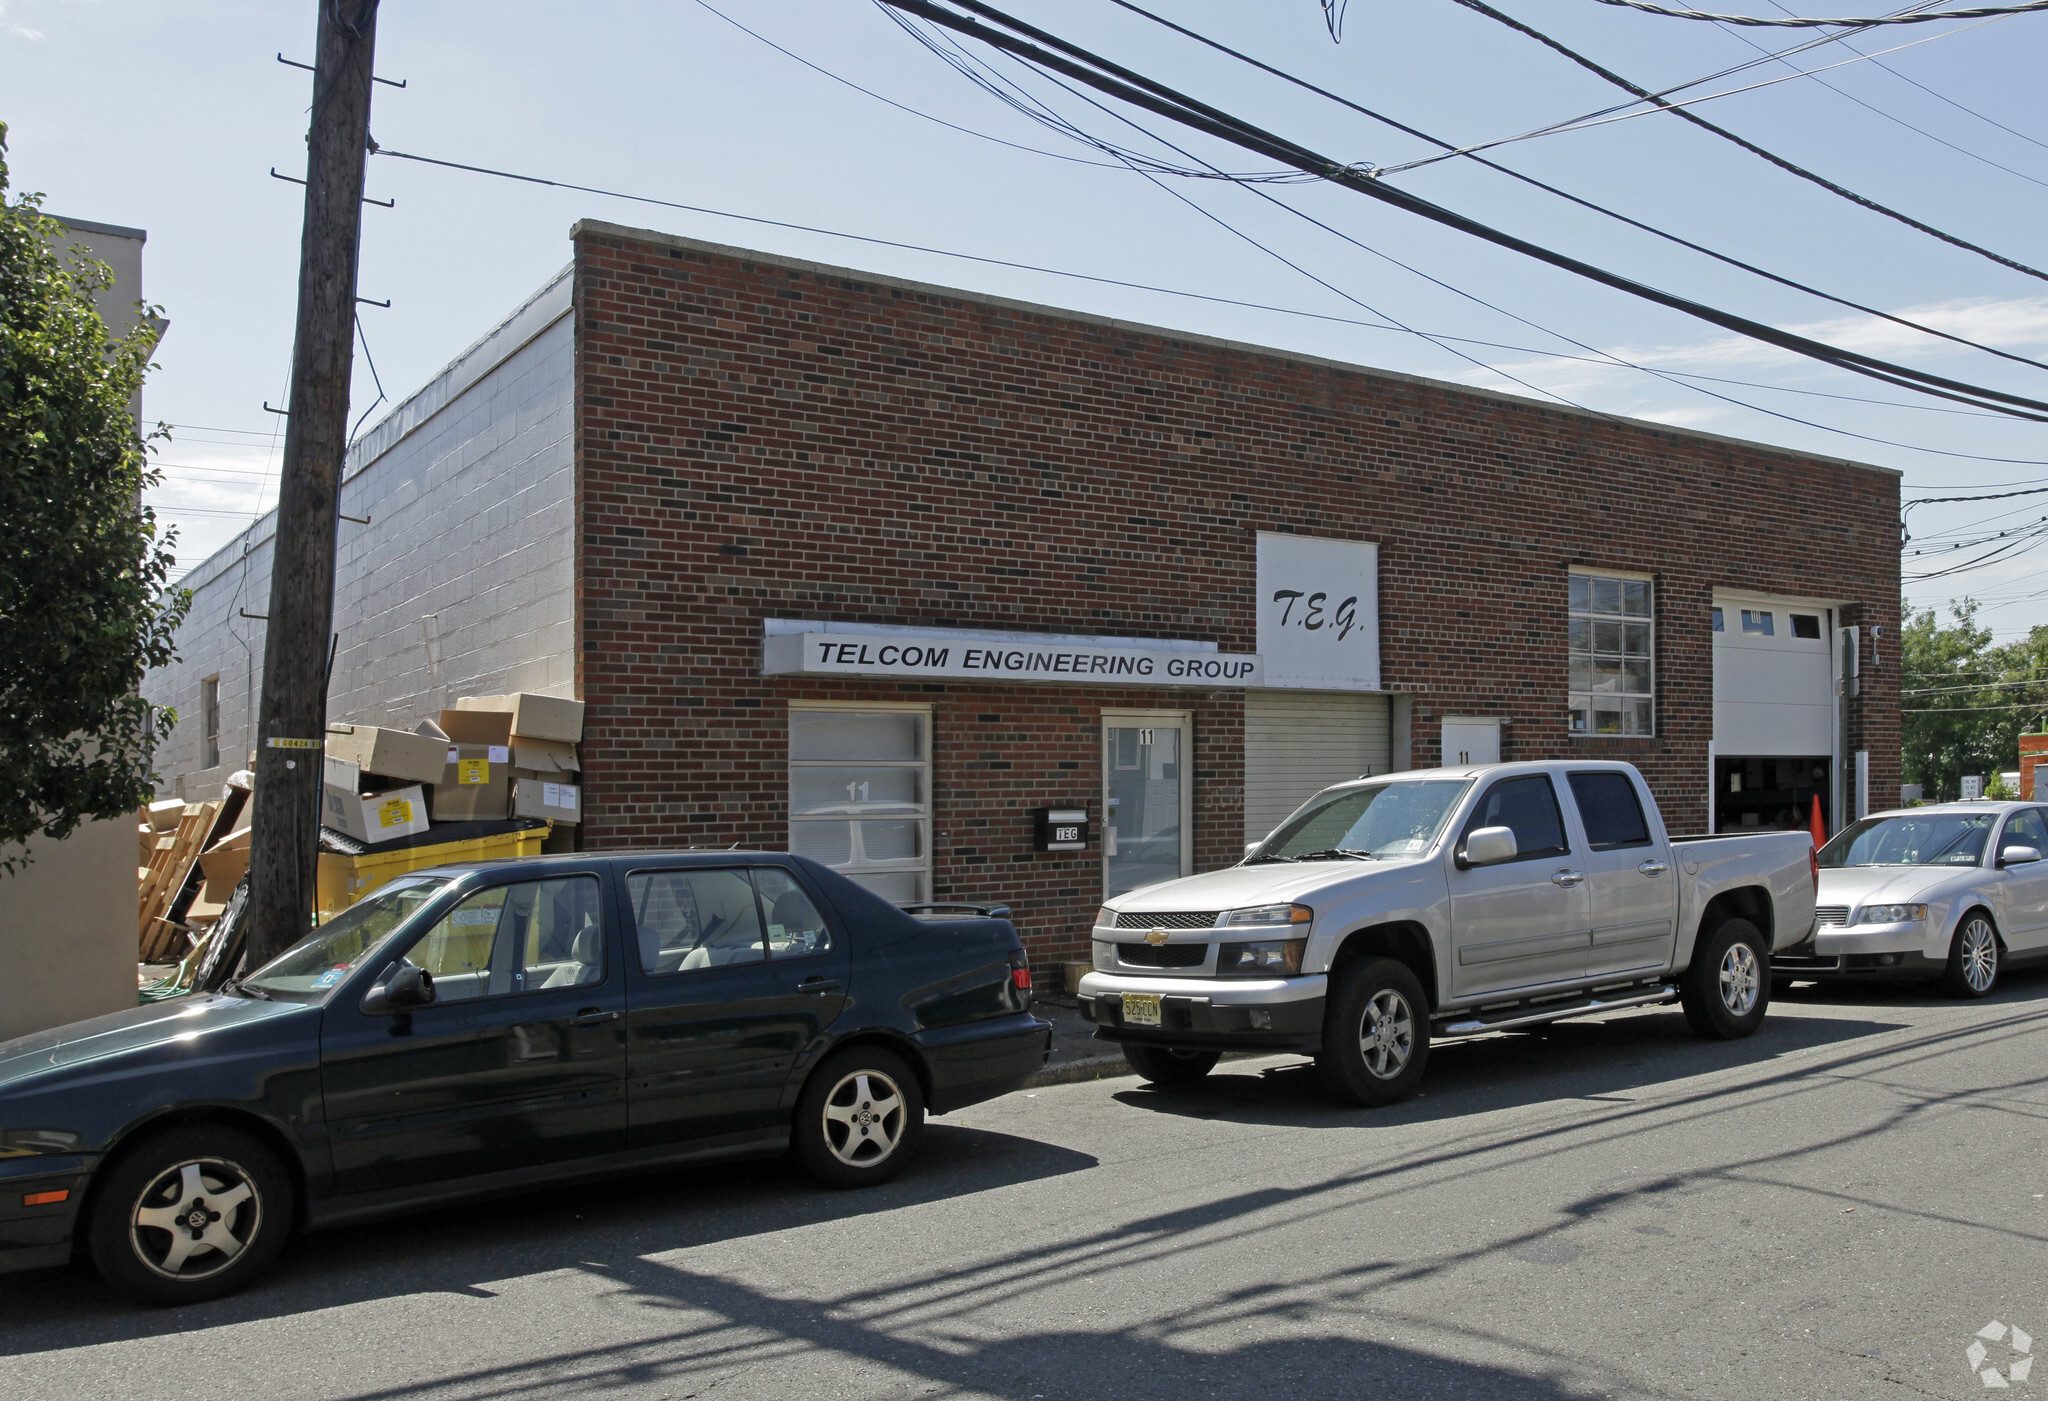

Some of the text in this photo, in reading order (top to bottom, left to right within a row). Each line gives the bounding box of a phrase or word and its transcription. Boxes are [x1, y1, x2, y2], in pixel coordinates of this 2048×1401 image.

[1273, 589, 1364, 642] T.E.G.
[818, 642, 1255, 679] TELCOM ENGINEERING GROUP
[1141, 729, 1153, 745] 11
[1459, 750, 1469, 765] 11
[846, 781, 869, 802] 11
[1057, 828, 1077, 840] TEG
